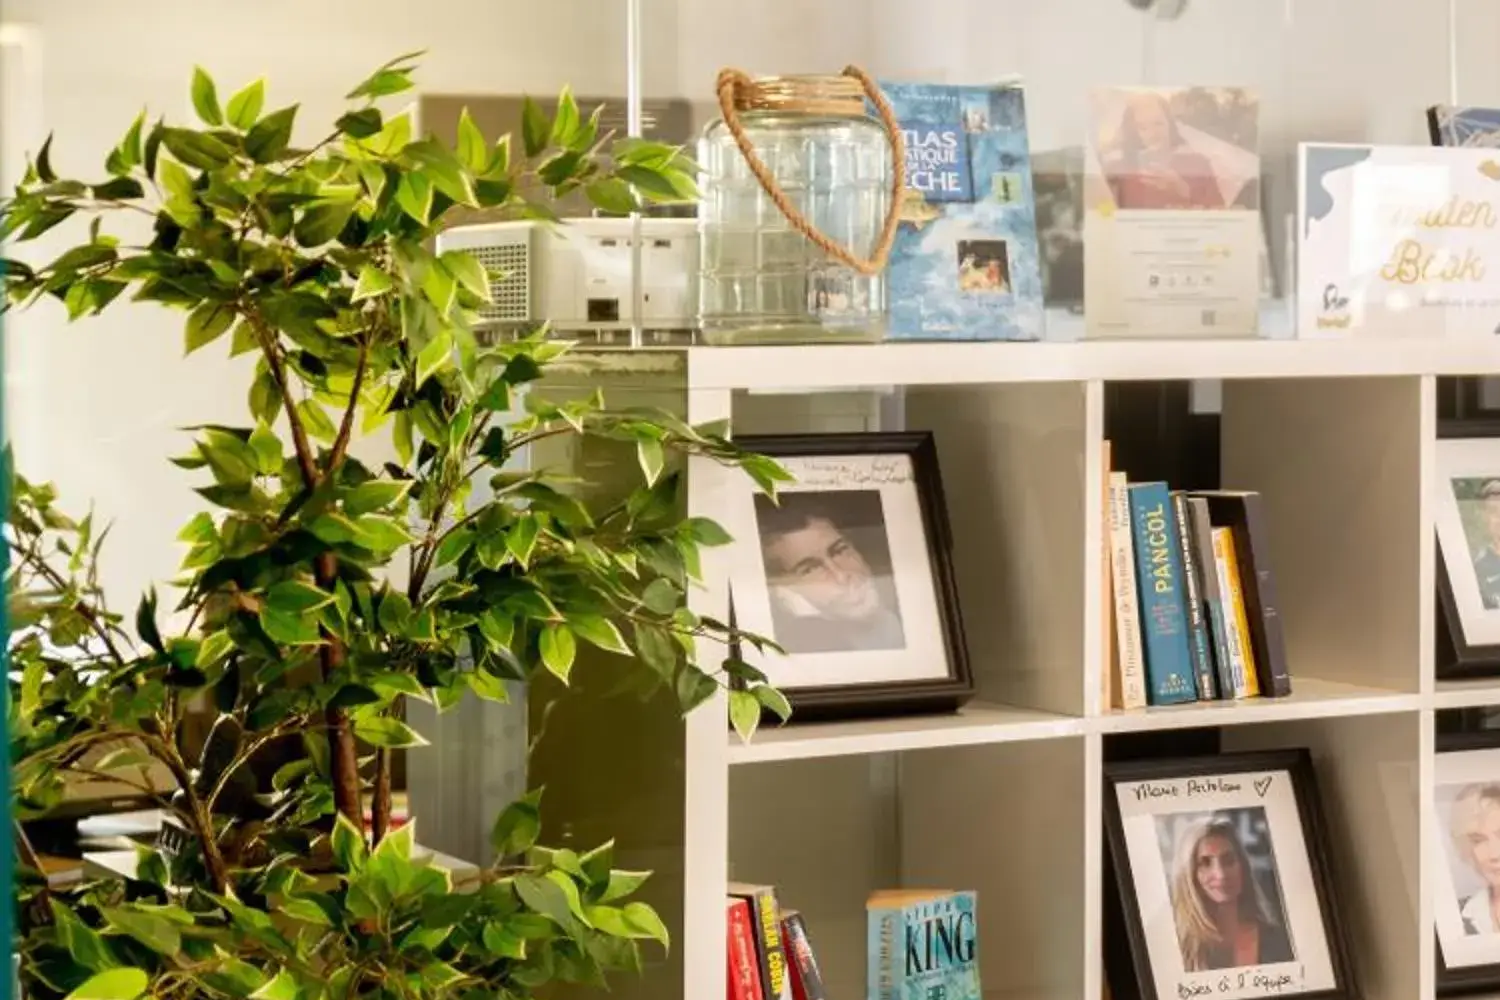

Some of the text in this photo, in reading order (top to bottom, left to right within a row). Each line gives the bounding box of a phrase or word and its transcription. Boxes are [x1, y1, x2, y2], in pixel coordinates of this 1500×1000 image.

[898, 129, 958, 147] TLAS
[1146, 502, 1175, 594] PANCOL
[905, 911, 975, 977] KING
